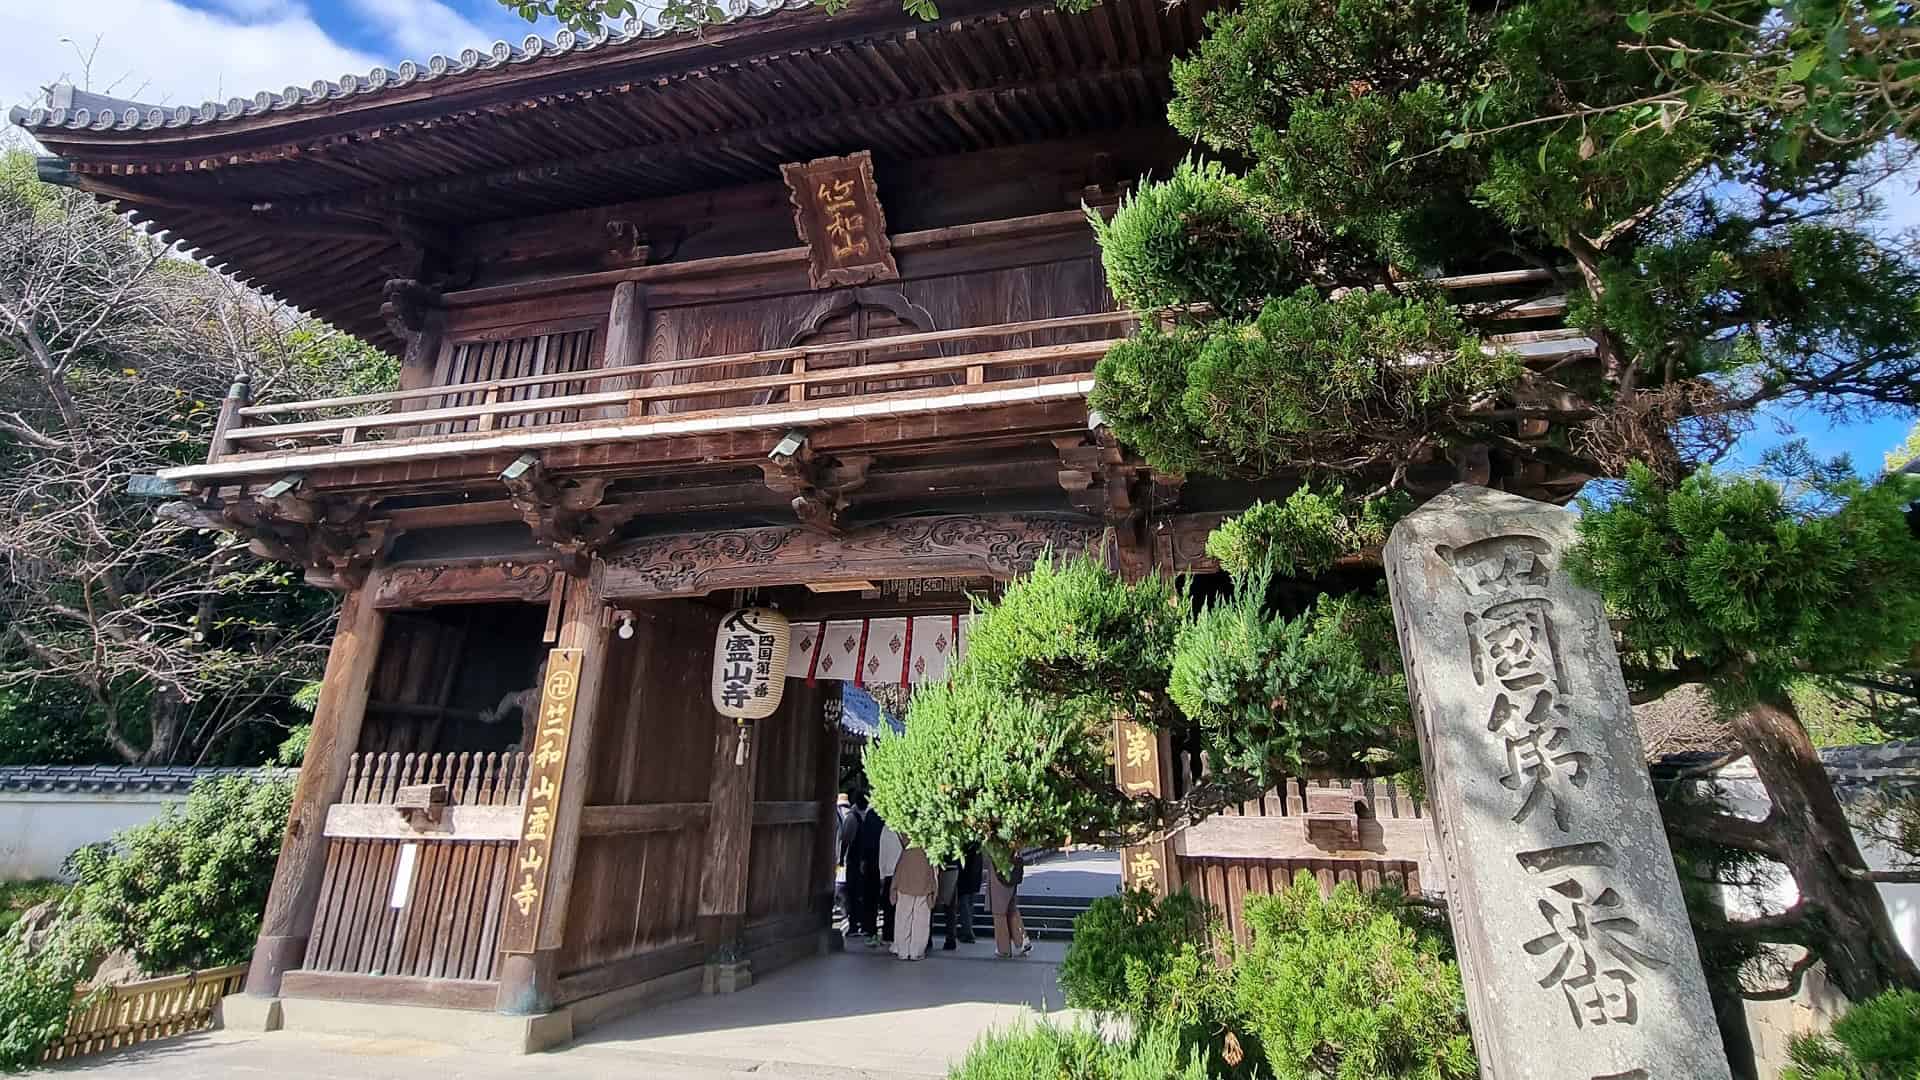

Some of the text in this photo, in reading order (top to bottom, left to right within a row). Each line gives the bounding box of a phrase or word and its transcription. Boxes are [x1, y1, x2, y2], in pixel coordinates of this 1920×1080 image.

[721, 635, 755, 709] 霊山寺
[754, 635, 776, 698] 四国第一番
[1434, 534, 1671, 1080] 四國第一番
